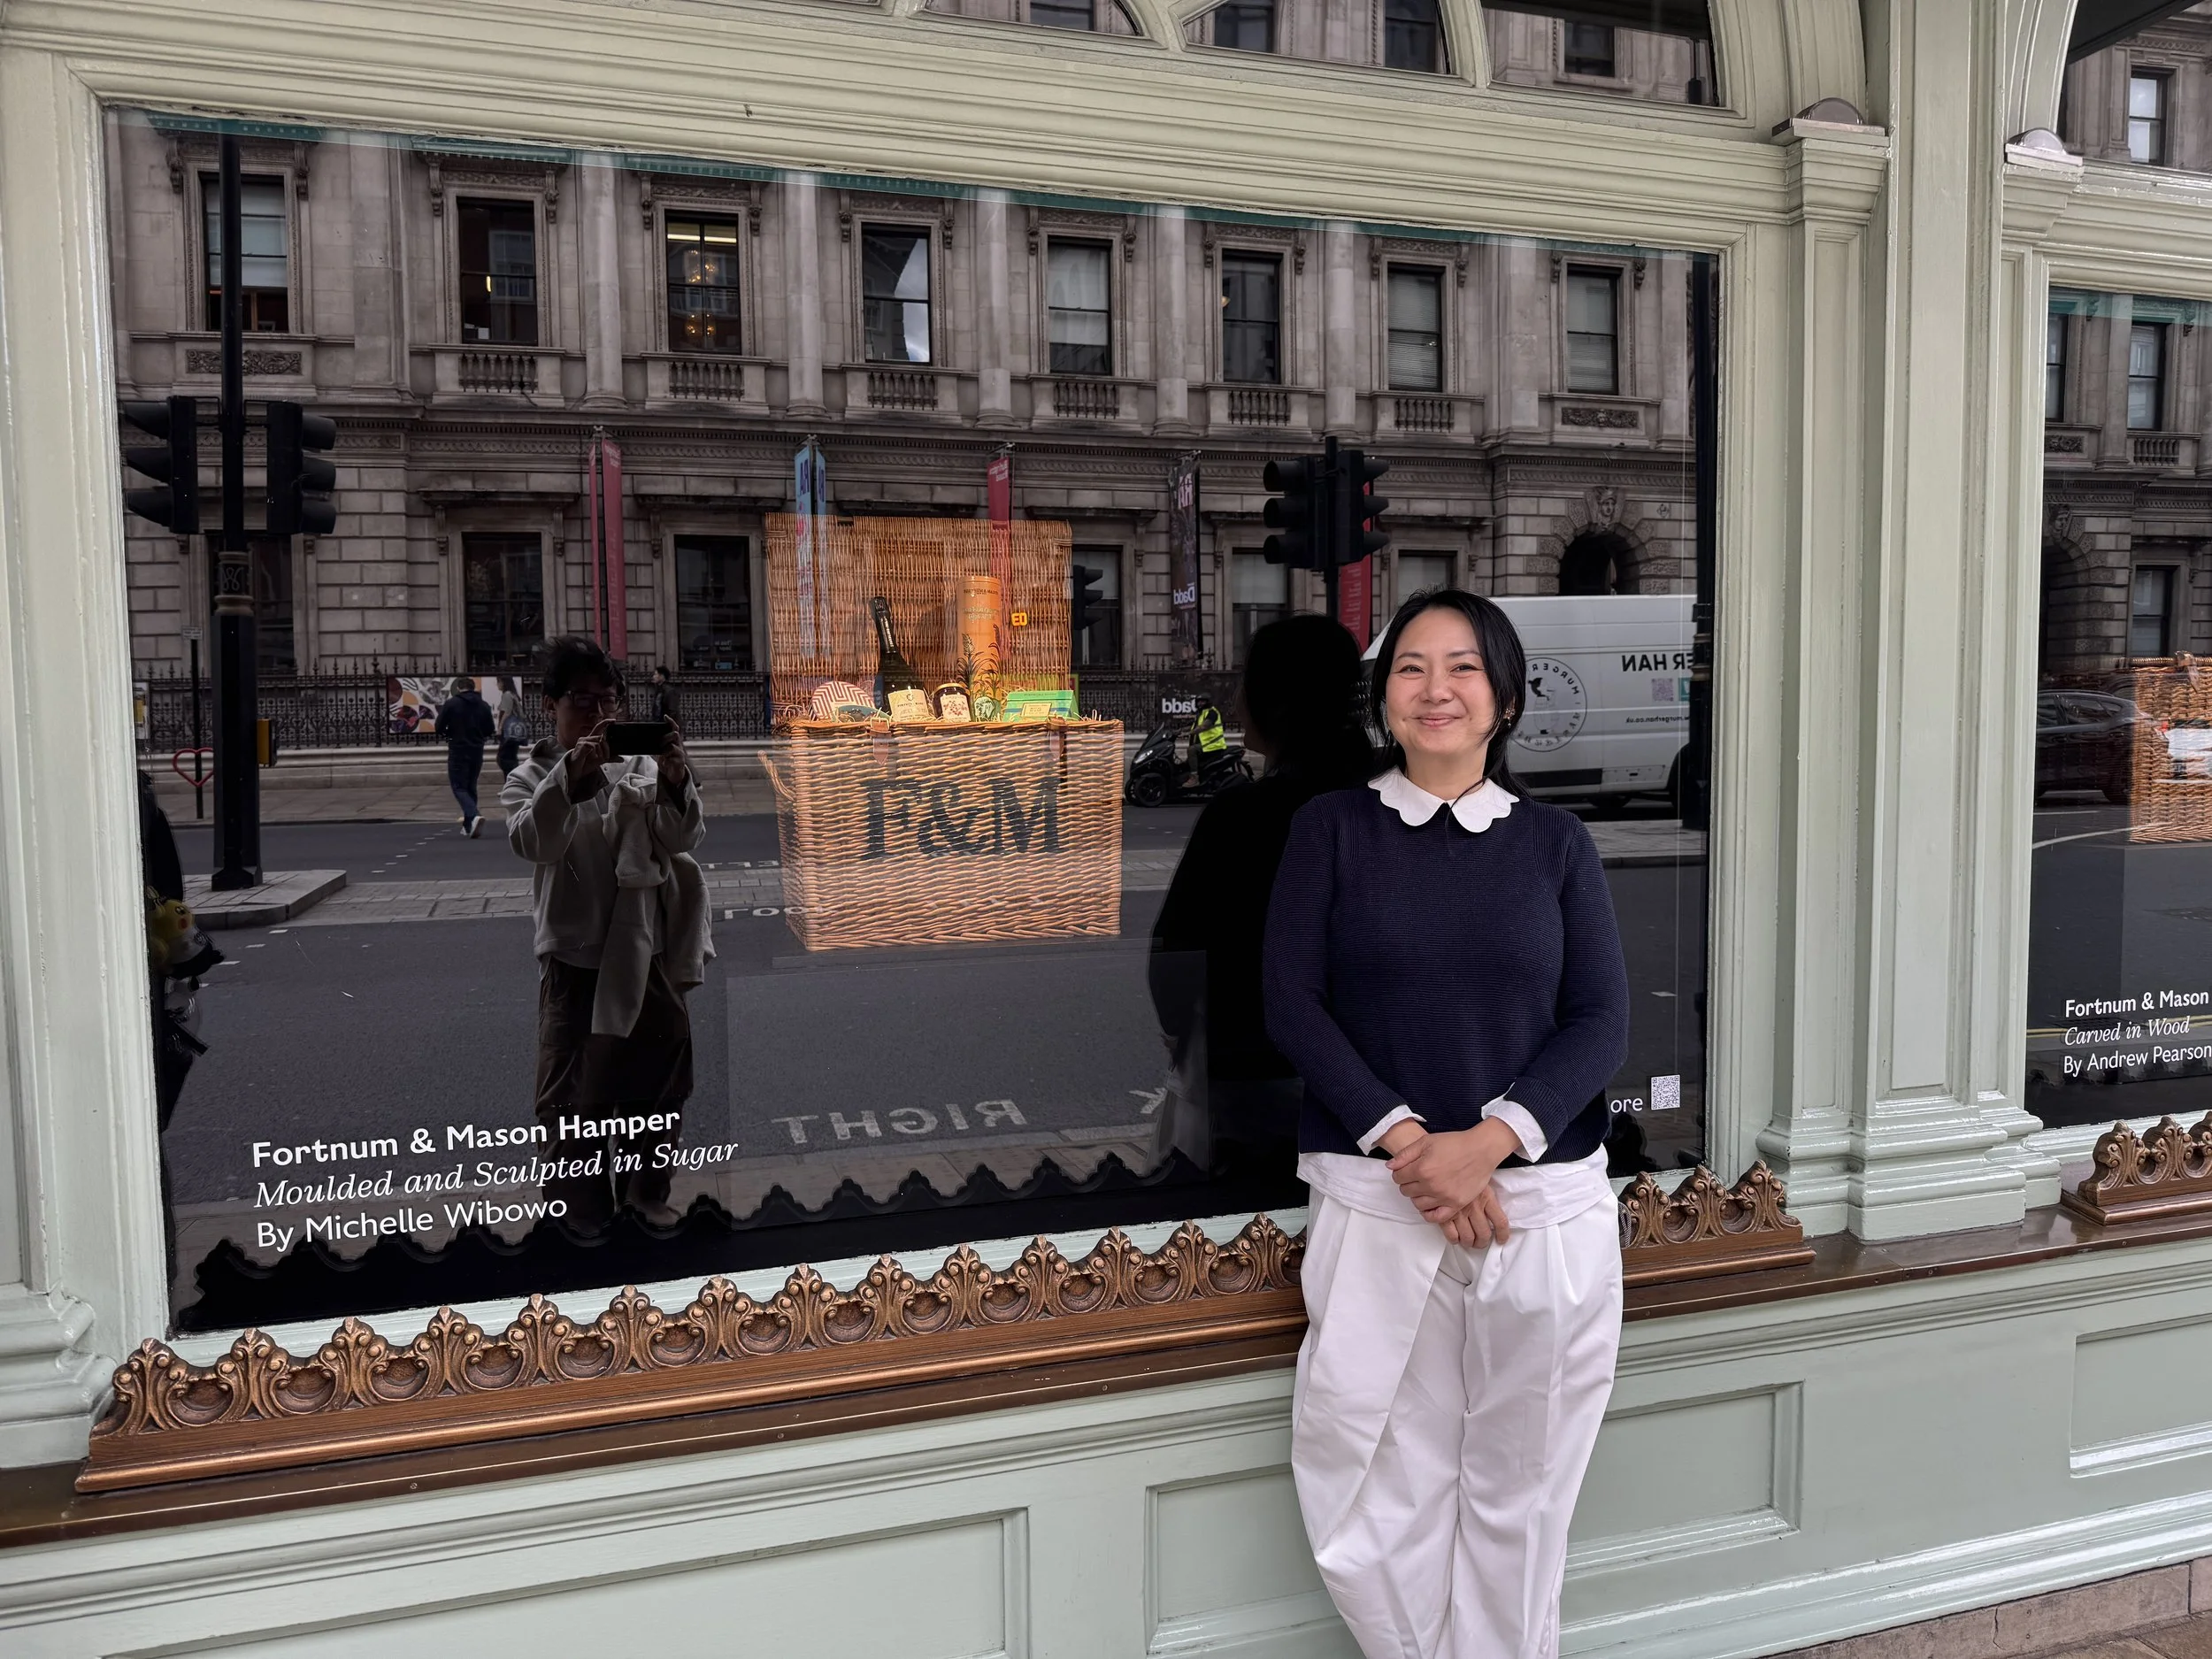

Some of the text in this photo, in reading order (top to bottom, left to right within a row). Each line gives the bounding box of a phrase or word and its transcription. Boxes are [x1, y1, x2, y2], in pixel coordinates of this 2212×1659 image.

[2065, 990, 2209, 1018] Fortnum & Mason
[2064, 1016, 2190, 1046] Carved in Wood
[2063, 1045, 2212, 1077] By Andrew Pearson
[1609, 1098, 1643, 1113] ore
[252, 1112, 680, 1167] Fortnum & Mason Hamper
[253, 1142, 739, 1209] Moulded and Sculpted in Sugar
[257, 1199, 567, 1253] By Michelle Wibowo
